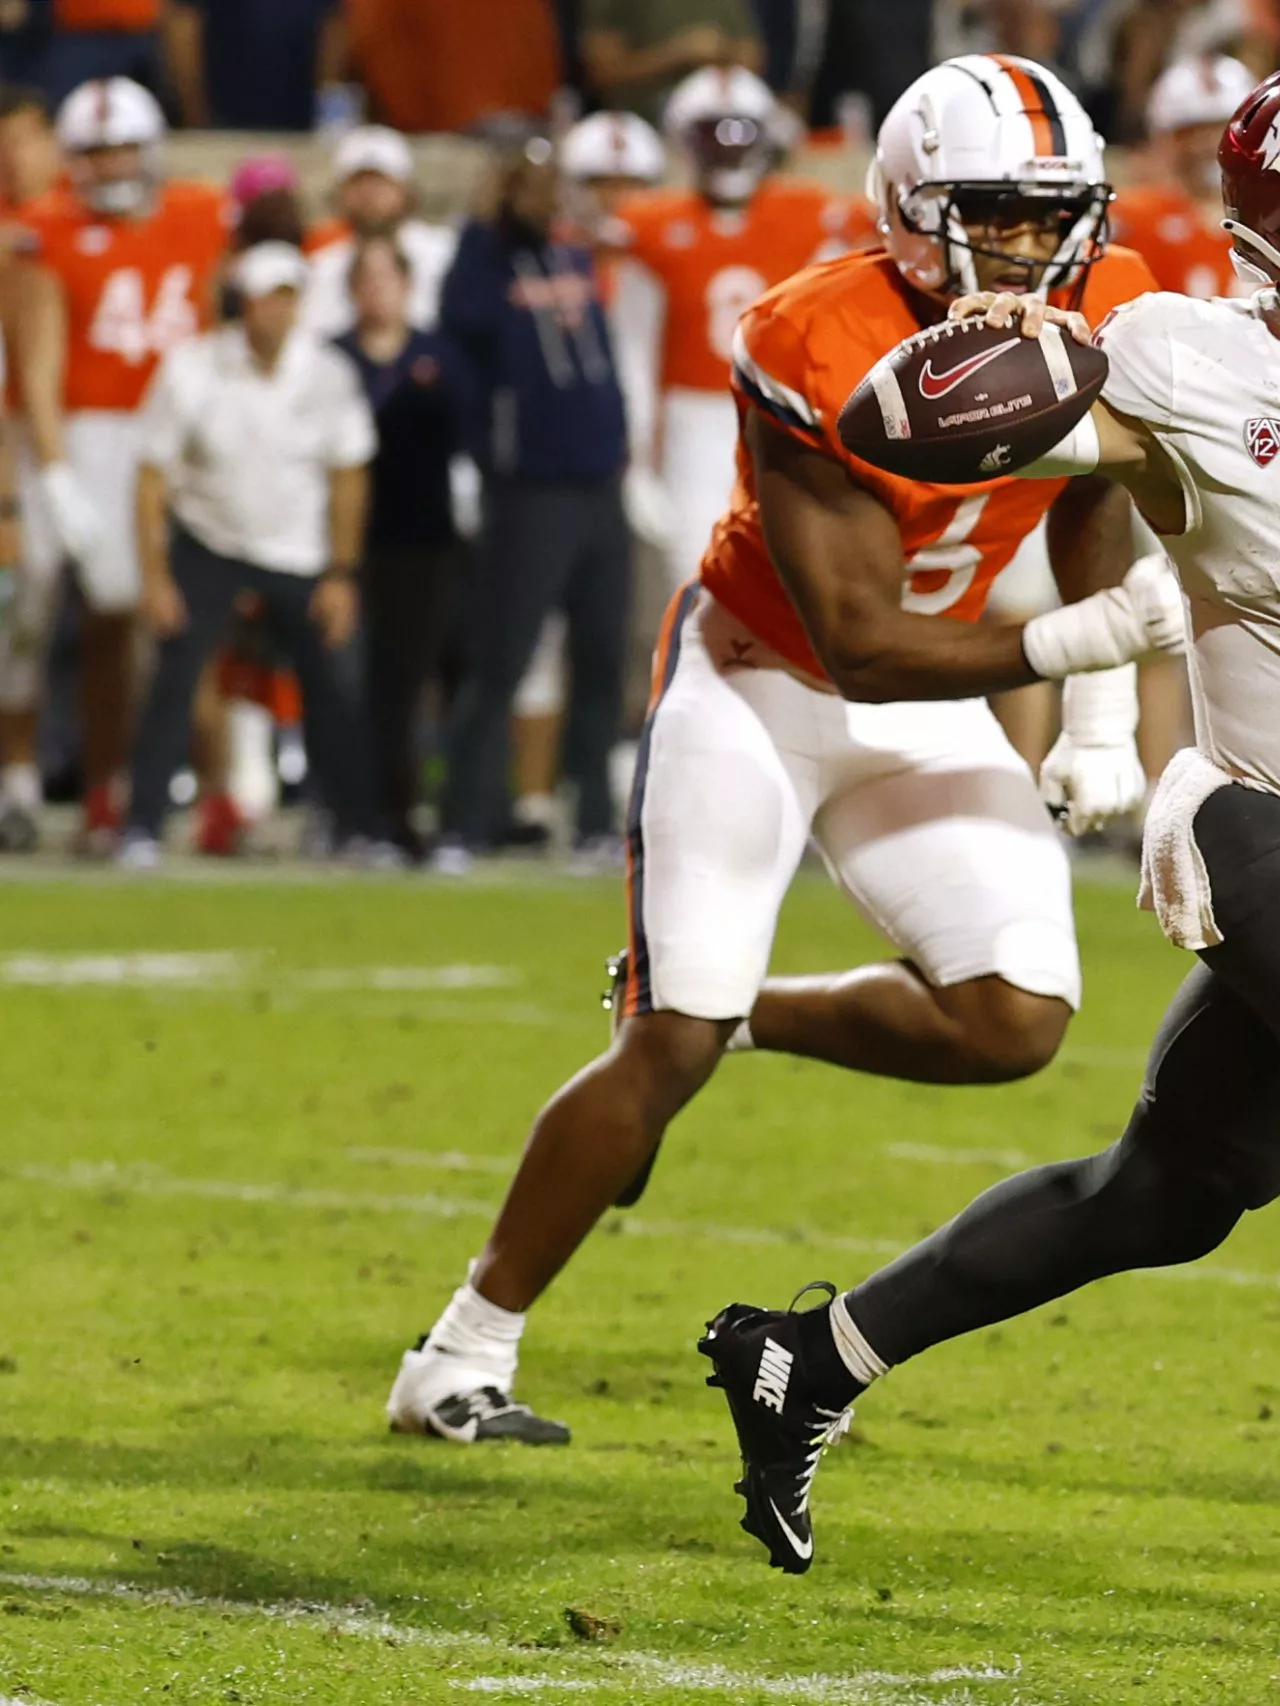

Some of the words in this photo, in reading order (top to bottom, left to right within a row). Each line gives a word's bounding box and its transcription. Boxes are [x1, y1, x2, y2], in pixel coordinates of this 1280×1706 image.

[1254, 438, 1274, 456] 12
[900, 493, 983, 616] 6
[753, 1336, 794, 1416] NIKE
